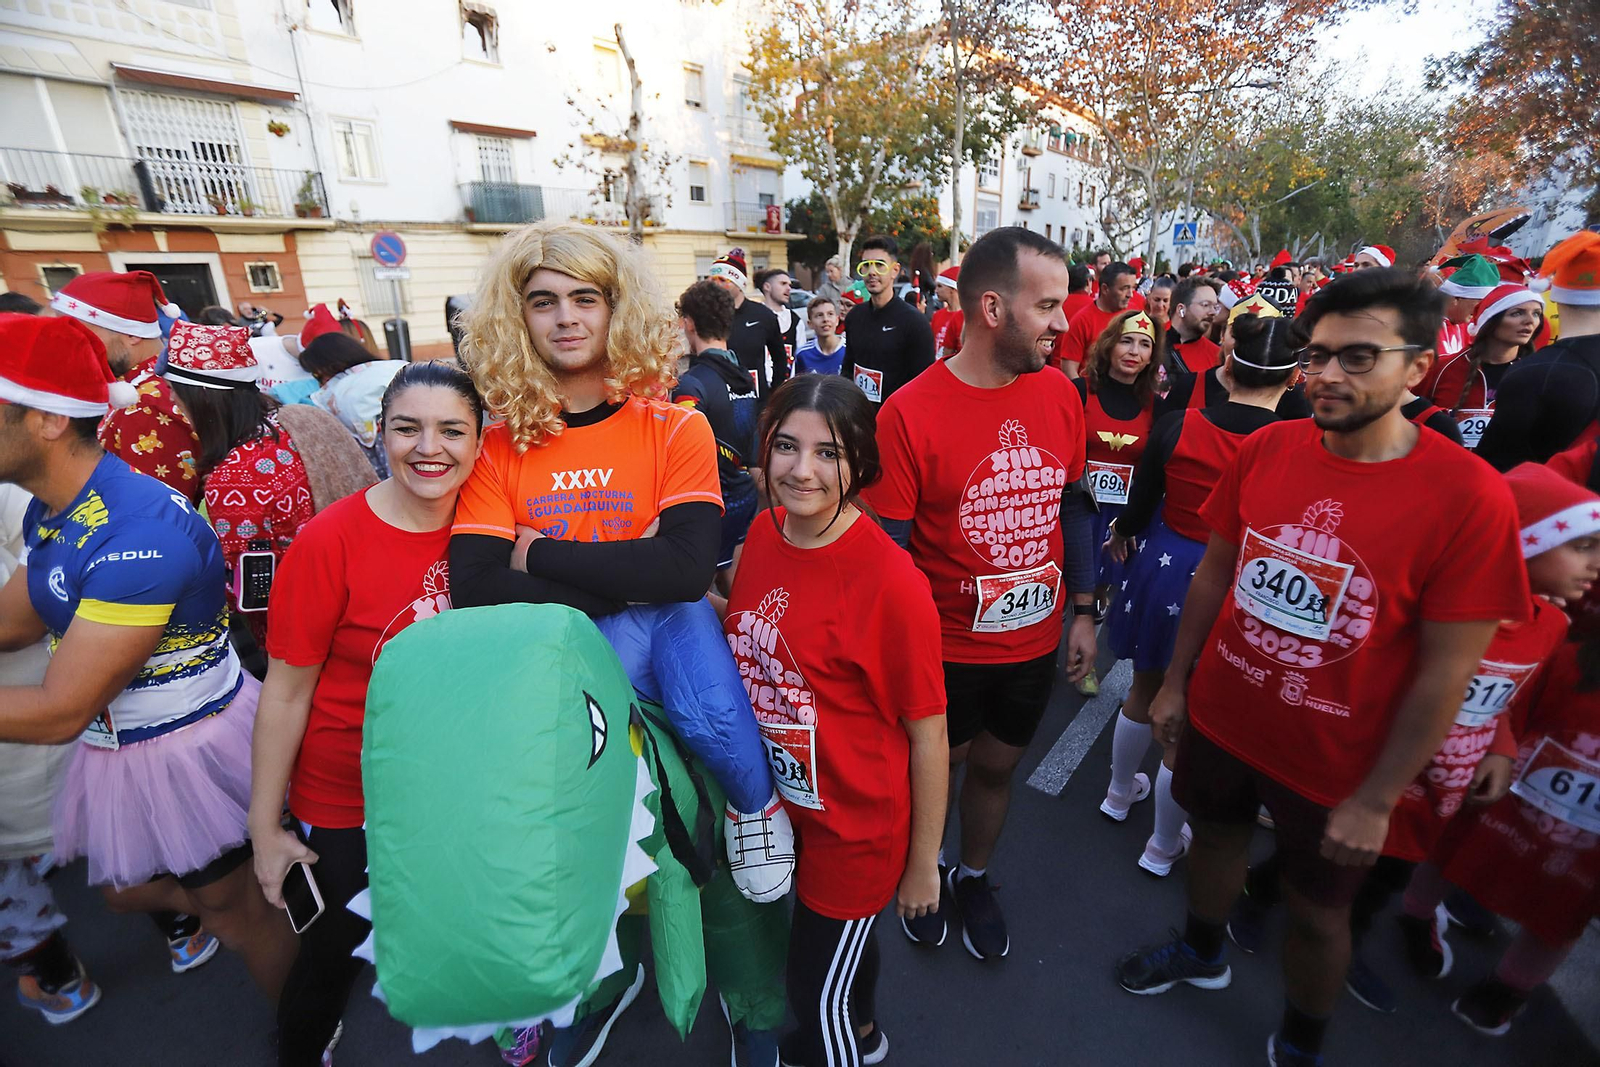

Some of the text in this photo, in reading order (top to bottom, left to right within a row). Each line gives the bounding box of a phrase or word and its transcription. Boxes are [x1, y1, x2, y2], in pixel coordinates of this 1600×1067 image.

[990, 446, 1042, 473] XIII
[551, 468, 614, 491] XXXV
[967, 466, 1066, 500] CARRERA
[1091, 473, 1118, 490] 169
[526, 490, 634, 507] CARRERA NOCTURNA
[534, 500, 634, 518] GUADALQUIVIR
[960, 495, 999, 517] SAN
[961, 515, 988, 529] DE
[969, 530, 998, 545] 30
[997, 532, 1014, 544] DE
[989, 538, 1049, 567] 2023
[1251, 559, 1307, 606] 340
[1001, 584, 1040, 615] 341
[1255, 590, 1280, 606] FRANCISCO
[737, 611, 778, 655] XIII
[1244, 617, 1323, 668] 2023
[1218, 639, 1266, 682] Huelva
[1304, 699, 1350, 718] HUELVA
